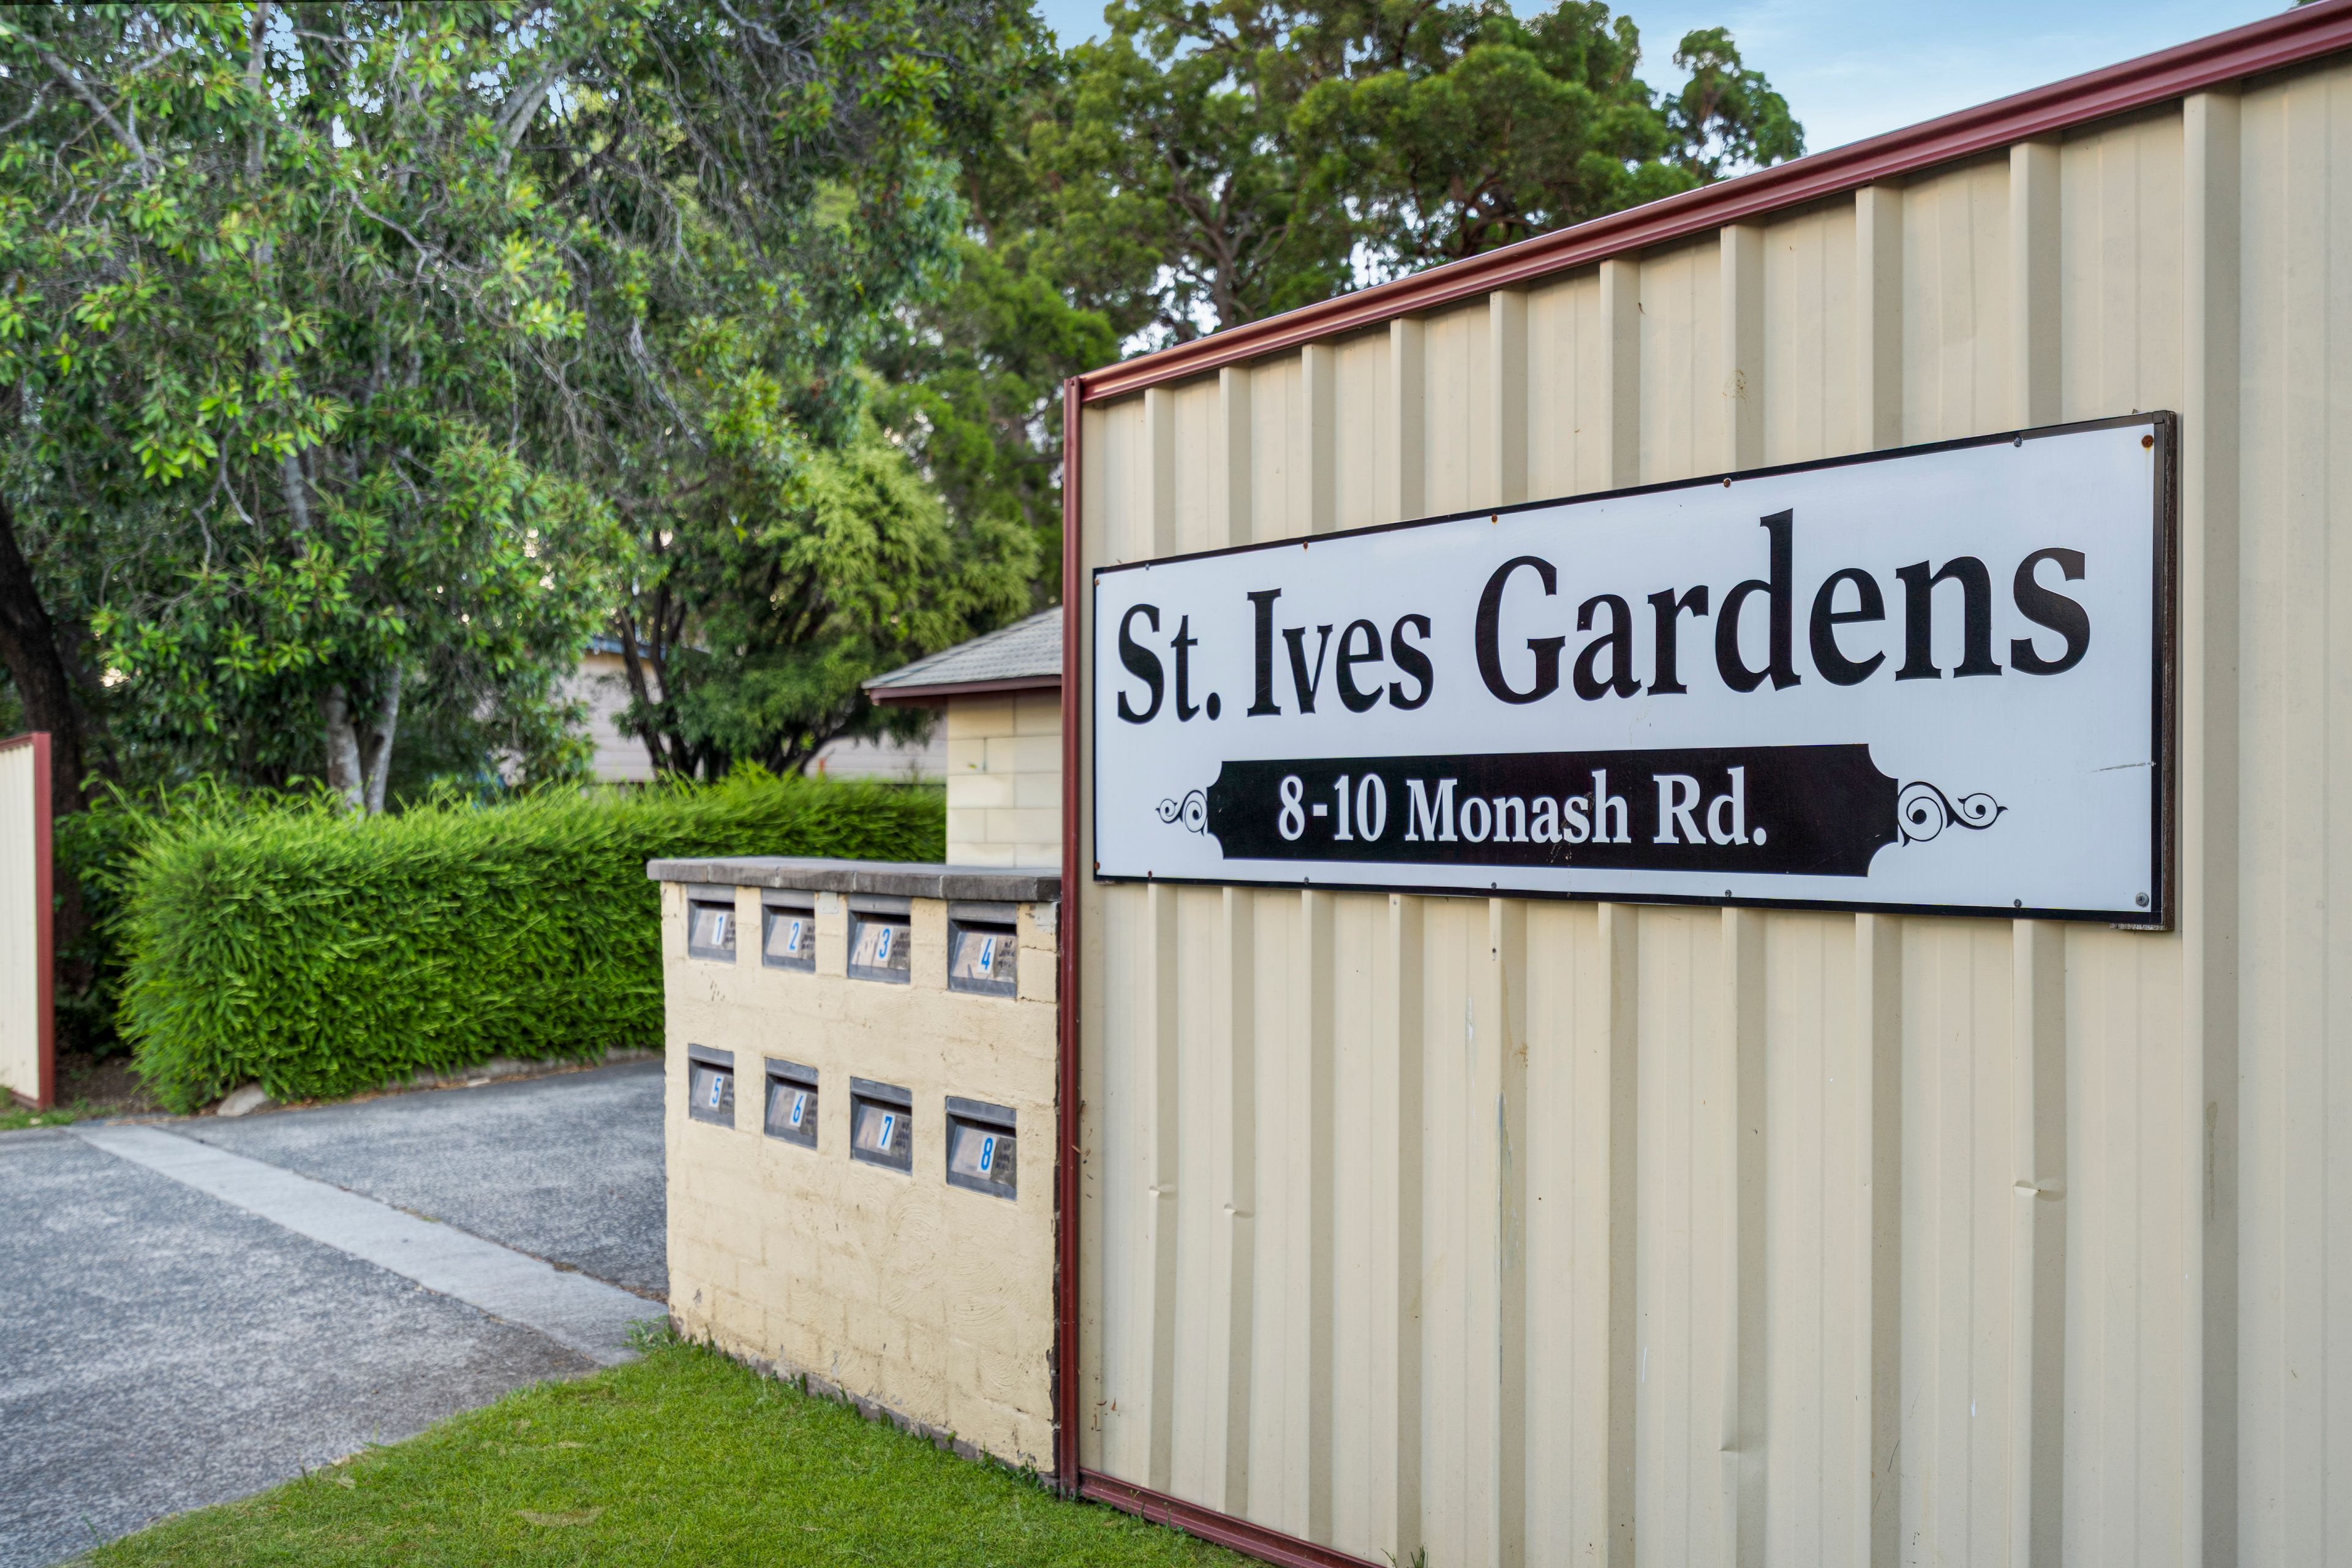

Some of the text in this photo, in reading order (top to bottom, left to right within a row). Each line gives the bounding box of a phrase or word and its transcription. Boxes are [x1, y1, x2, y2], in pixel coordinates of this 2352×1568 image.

[1118, 508, 2091, 725] St. Ives Gardens
[1279, 766, 1766, 845] 8-10 Monash Rd.
[716, 916, 723, 943] 1
[788, 921, 799, 951] 2
[878, 928, 891, 959] 3
[981, 938, 992, 970] 4
[712, 1077, 722, 1104] 5
[793, 1095, 804, 1123] 6
[881, 1115, 892, 1146] 7
[981, 1137, 993, 1170] 8
